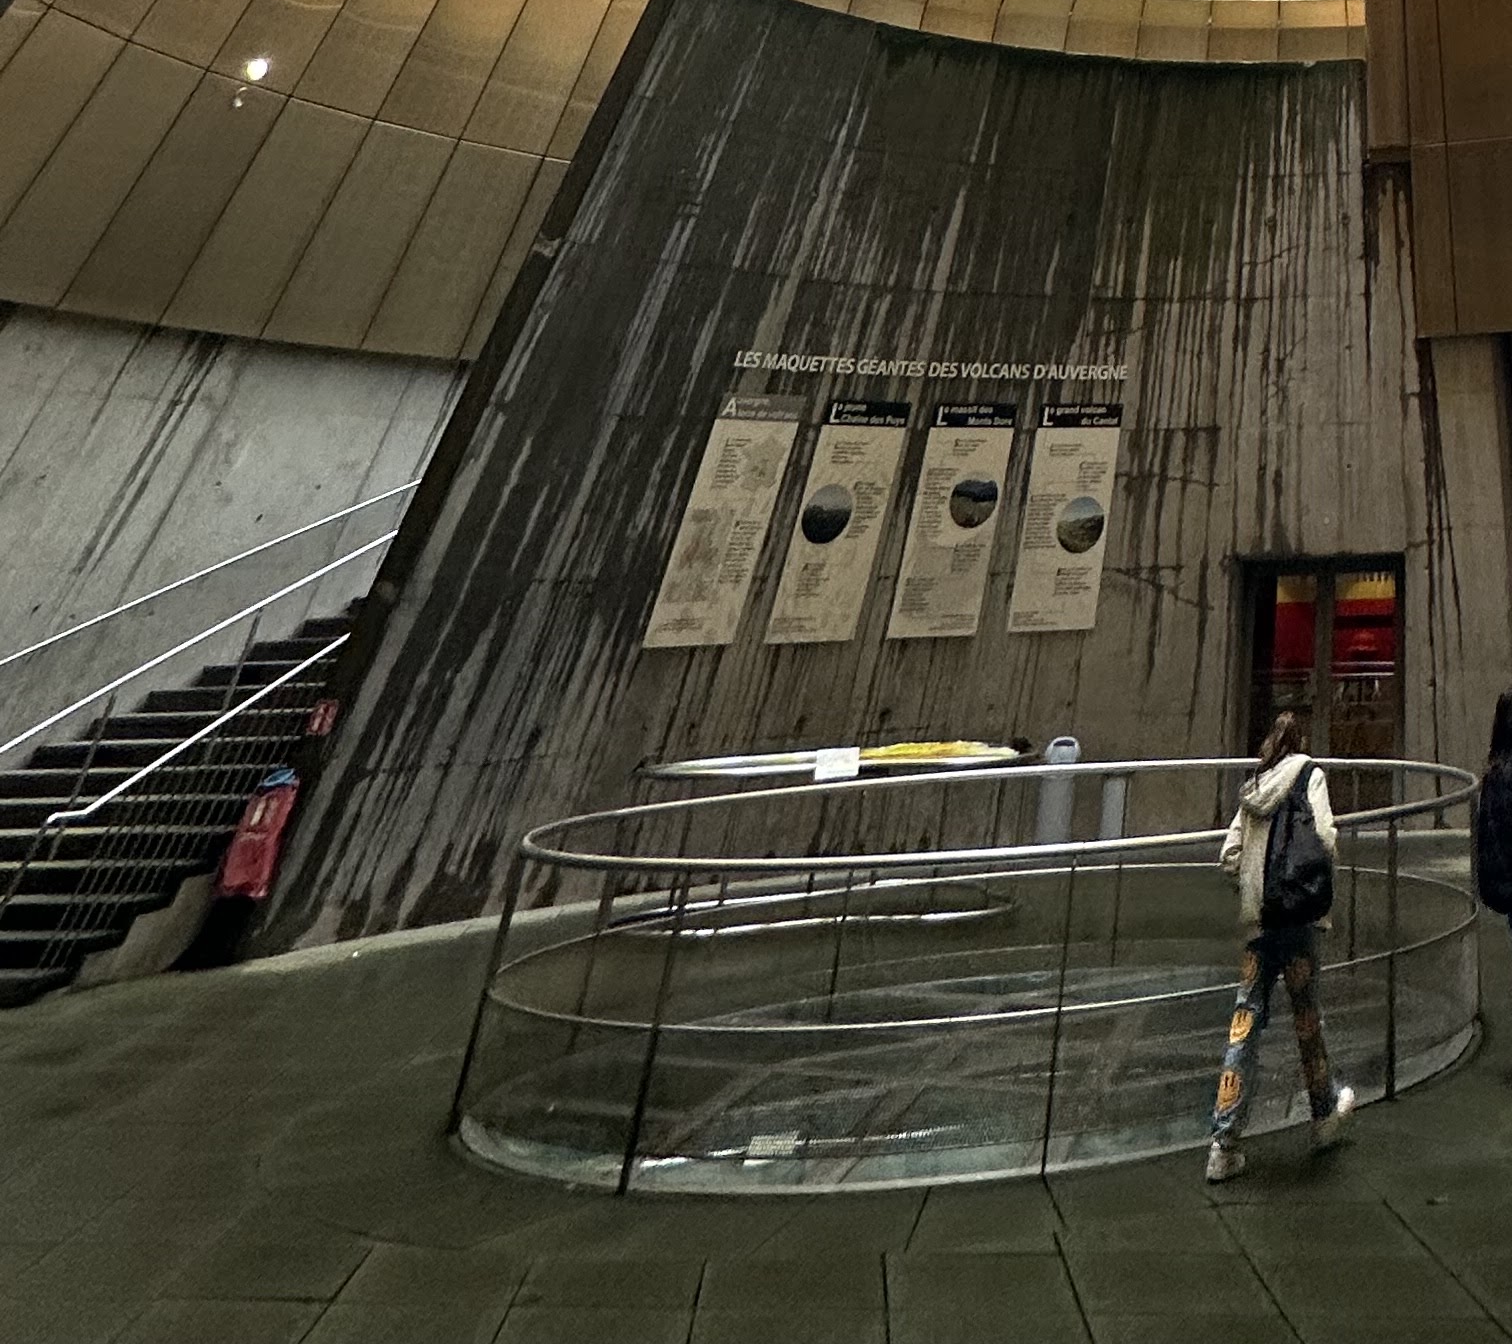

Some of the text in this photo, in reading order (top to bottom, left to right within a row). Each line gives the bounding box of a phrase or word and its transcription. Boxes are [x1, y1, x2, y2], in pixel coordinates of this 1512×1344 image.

[734, 351, 1128, 380] LES MAQUETTES GÉANTES DES VOLCANS D'AUVERGNE
